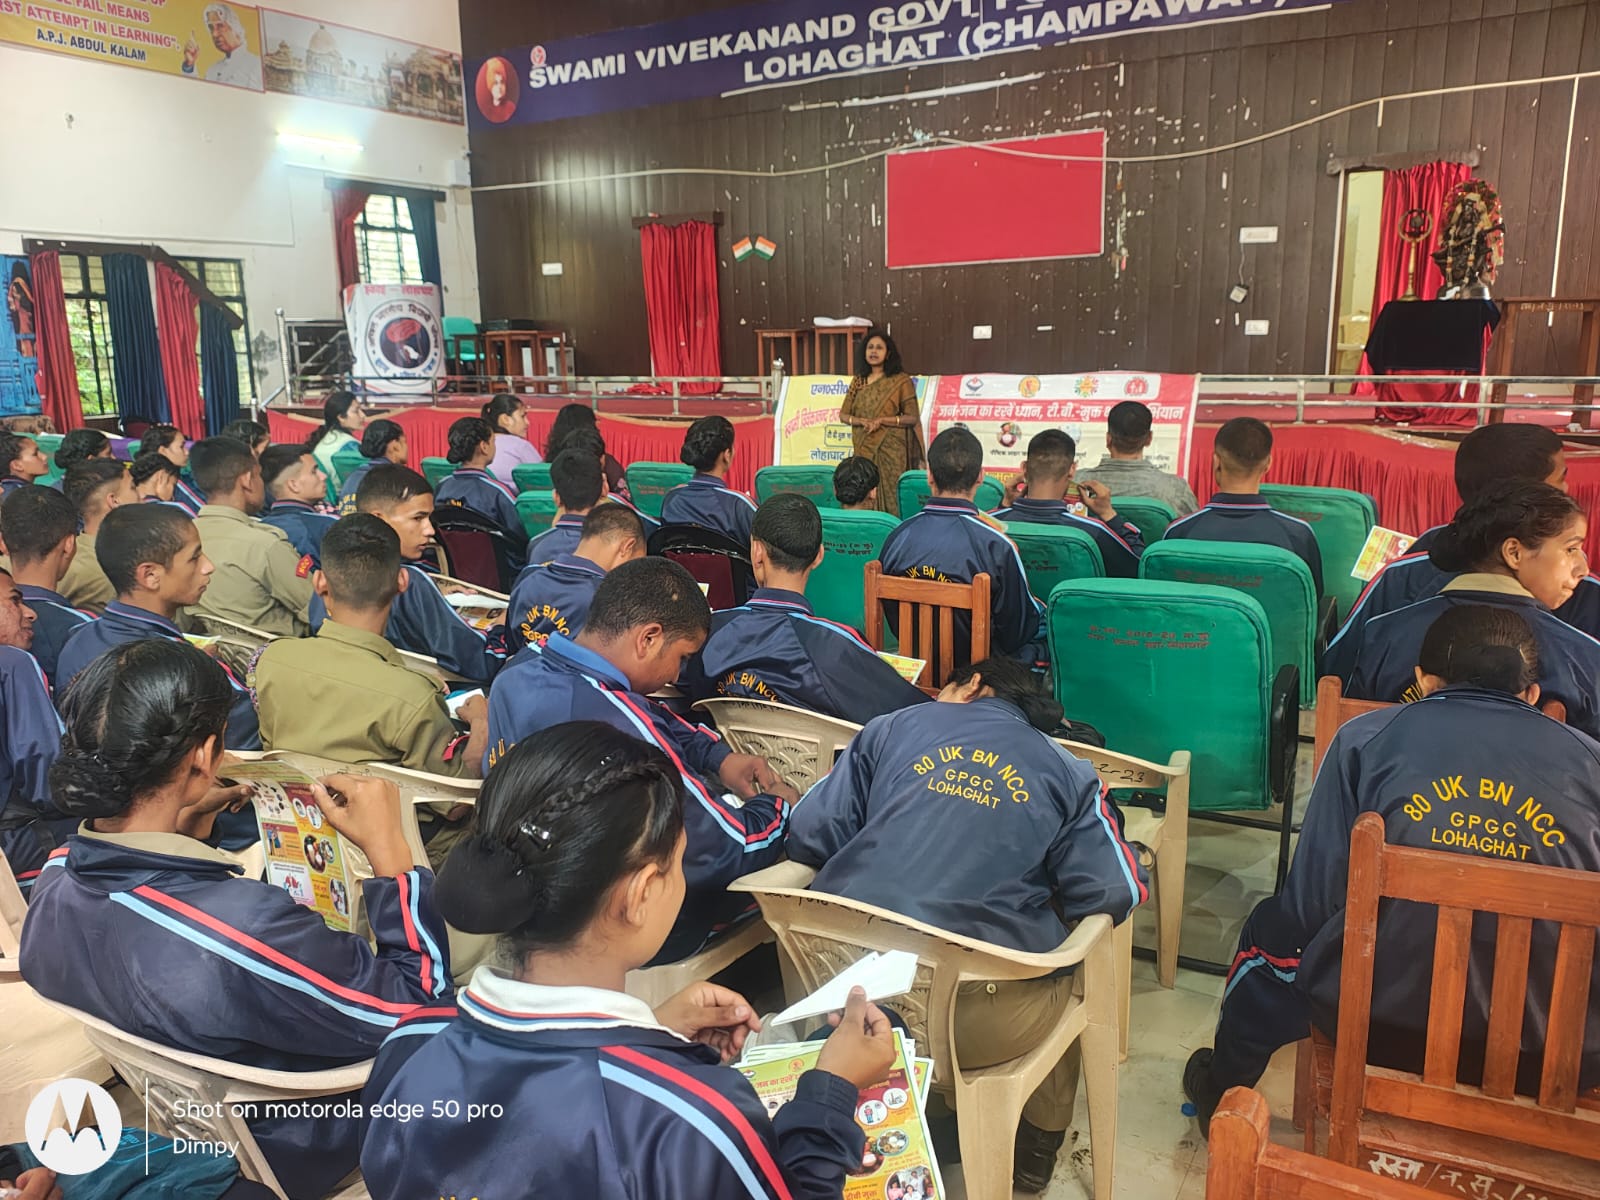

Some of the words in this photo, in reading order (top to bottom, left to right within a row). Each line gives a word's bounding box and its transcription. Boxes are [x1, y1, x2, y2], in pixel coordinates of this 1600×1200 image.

[28, 5, 89, 30] ATTEMPT
[93, 20, 107, 34] IN
[107, 3, 150, 23] MEANS
[37, 28, 67, 46] A.P.J.
[70, 36, 107, 53] ABDUL
[110, 44, 146, 61] KALAM
[529, 53, 626, 88] SWAMI
[635, 14, 856, 71] VIVEKANAND
[744, 31, 945, 83] LOHAGHAT
[923, 566, 935, 578] BN
[526, 605, 540, 623] UK
[543, 604, 559, 621] BN
[740, 672, 757, 688] BN
[913, 755, 936, 775] 80
[938, 746, 964, 763] UK
[971, 749, 999, 768] BN
[997, 764, 1030, 803] NCC
[945, 768, 994, 792] GPGC
[927, 777, 1001, 809] LOHAGHAT
[1403, 793, 1432, 822] 80
[1431, 775, 1469, 801] UK
[1479, 777, 1514, 807] BN
[1516, 796, 1566, 847] NCC
[1450, 811, 1517, 837] GPGC
[1431, 827, 1532, 860] LOHAGHAT
